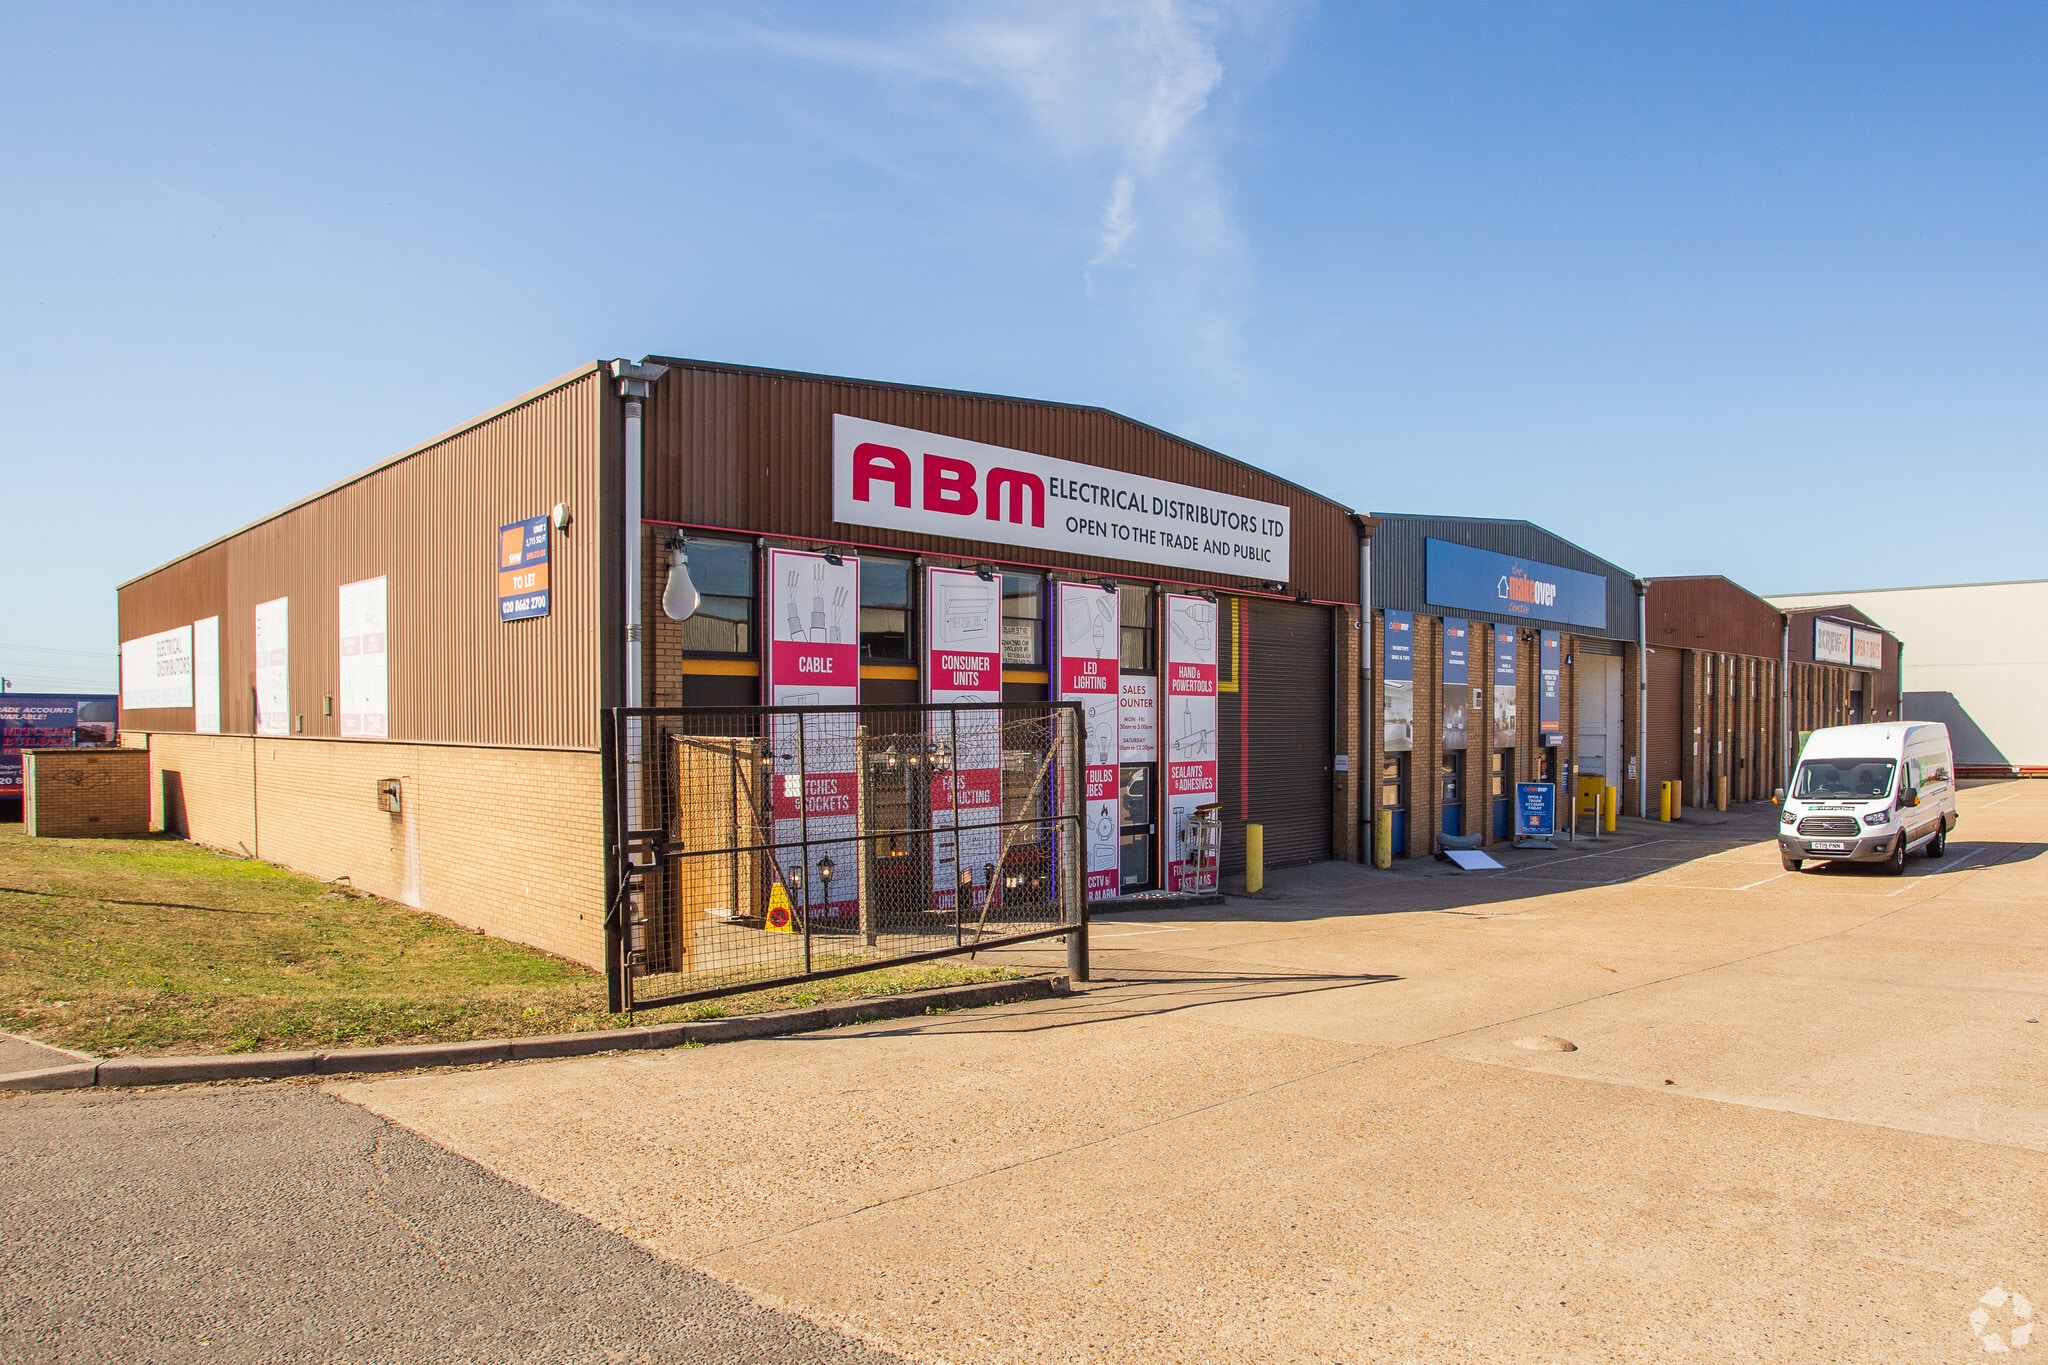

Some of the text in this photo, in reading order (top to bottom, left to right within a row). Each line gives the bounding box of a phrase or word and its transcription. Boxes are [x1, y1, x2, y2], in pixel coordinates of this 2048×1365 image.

[852, 442, 1045, 529] ABM
[1049, 477, 1284, 537] ELECTRICAL DISTRIBUTORS LTD
[1066, 517, 1271, 563] OPEN TO THE TRADE AND PUBLIC
[508, 552, 522, 565] SHW
[513, 573, 536, 590] TO LET
[1509, 574, 1556, 606] makeover
[502, 595, 546, 614] 020 8662 2700
[157, 637, 182, 657] ELECTRICAL
[1818, 629, 1848, 655] SCREWFIX
[1854, 638, 1866, 656] OPEN
[157, 656, 190, 677] DISTRIBUTORS
[798, 656, 833, 674] CABLE
[941, 655, 990, 672] CONSUMER
[1083, 661, 1097, 675] LED
[953, 671, 979, 687] UNITS
[1178, 666, 1200, 679] HAND &
[1073, 675, 1107, 690] LIGHTING
[1122, 685, 1146, 695] SALES
[1172, 679, 1213, 693] POWERTOOLS
[1120, 698, 1153, 708] OUNTER
[3, 727, 74, 737] MITCHAM
[1090, 769, 1113, 782] BULBS
[1171, 765, 1202, 779] SEALANTS
[1175, 777, 1213, 791] & ADHESIVES
[1088, 875, 1104, 888] CCTV
